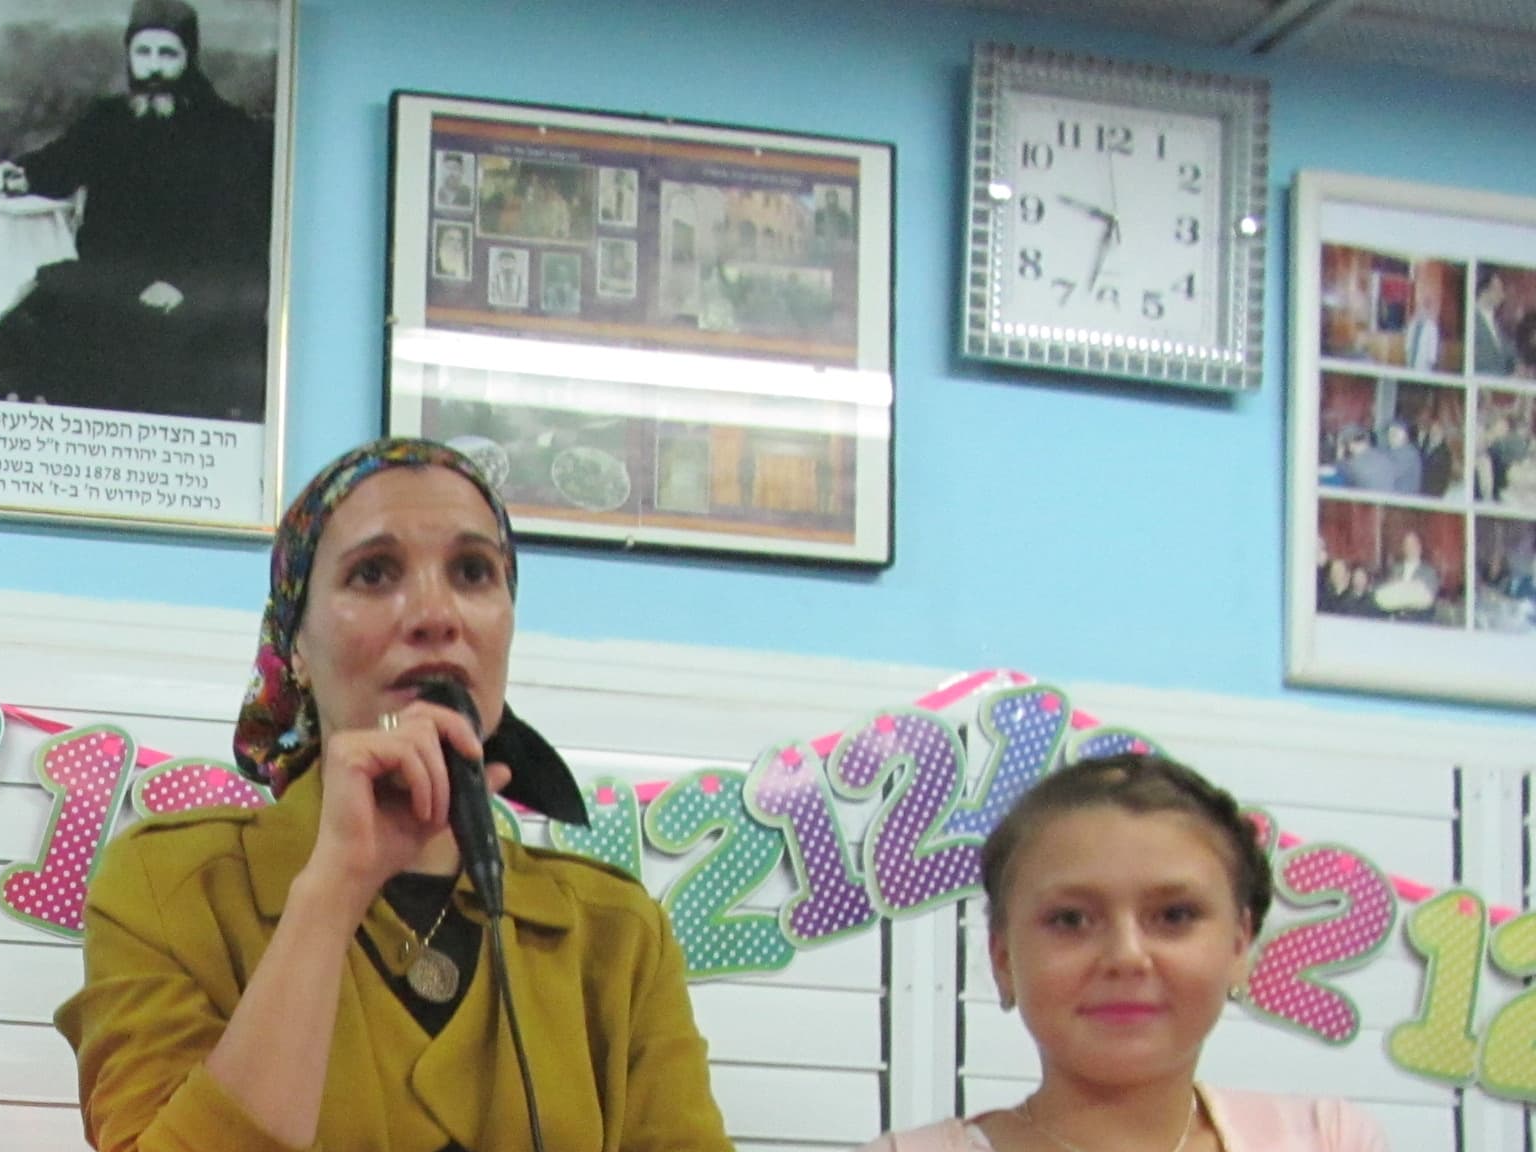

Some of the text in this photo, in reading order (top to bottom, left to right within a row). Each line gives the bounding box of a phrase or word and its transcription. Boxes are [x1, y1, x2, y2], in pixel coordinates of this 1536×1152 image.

[1057, 121, 1081, 149] 11
[1096, 125, 1134, 156] 12
[1021, 142, 1053, 170] 10
[1178, 163, 1202, 195] 2
[1019, 195, 1045, 225] 9
[1175, 216, 1200, 245] 3
[1019, 249, 1043, 280] 8
[1051, 278, 1077, 307] 7
[1171, 273, 1195, 300] 4
[1142, 290, 1164, 320] 5
[61, 412, 133, 440] המקובל
[138, 423, 195, 445] הצדיק
[65, 441, 107, 457] ושרה
[200, 430, 237, 448] הרב
[111, 445, 157, 461] יהודה
[162, 450, 194, 465] הרב
[199, 453, 215, 469] בן
[39, 461, 81, 478] נפטר
[84, 465, 121, 481] 1878
[126, 468, 169, 486] בשנת
[175, 471, 209, 489] נולד
[11, 480, 44, 495] אדר
[105, 486, 152, 506] קידוש
[157, 489, 177, 508] על
[181, 493, 221, 510] נרצח
[744, 738, 1004, 920] 12
